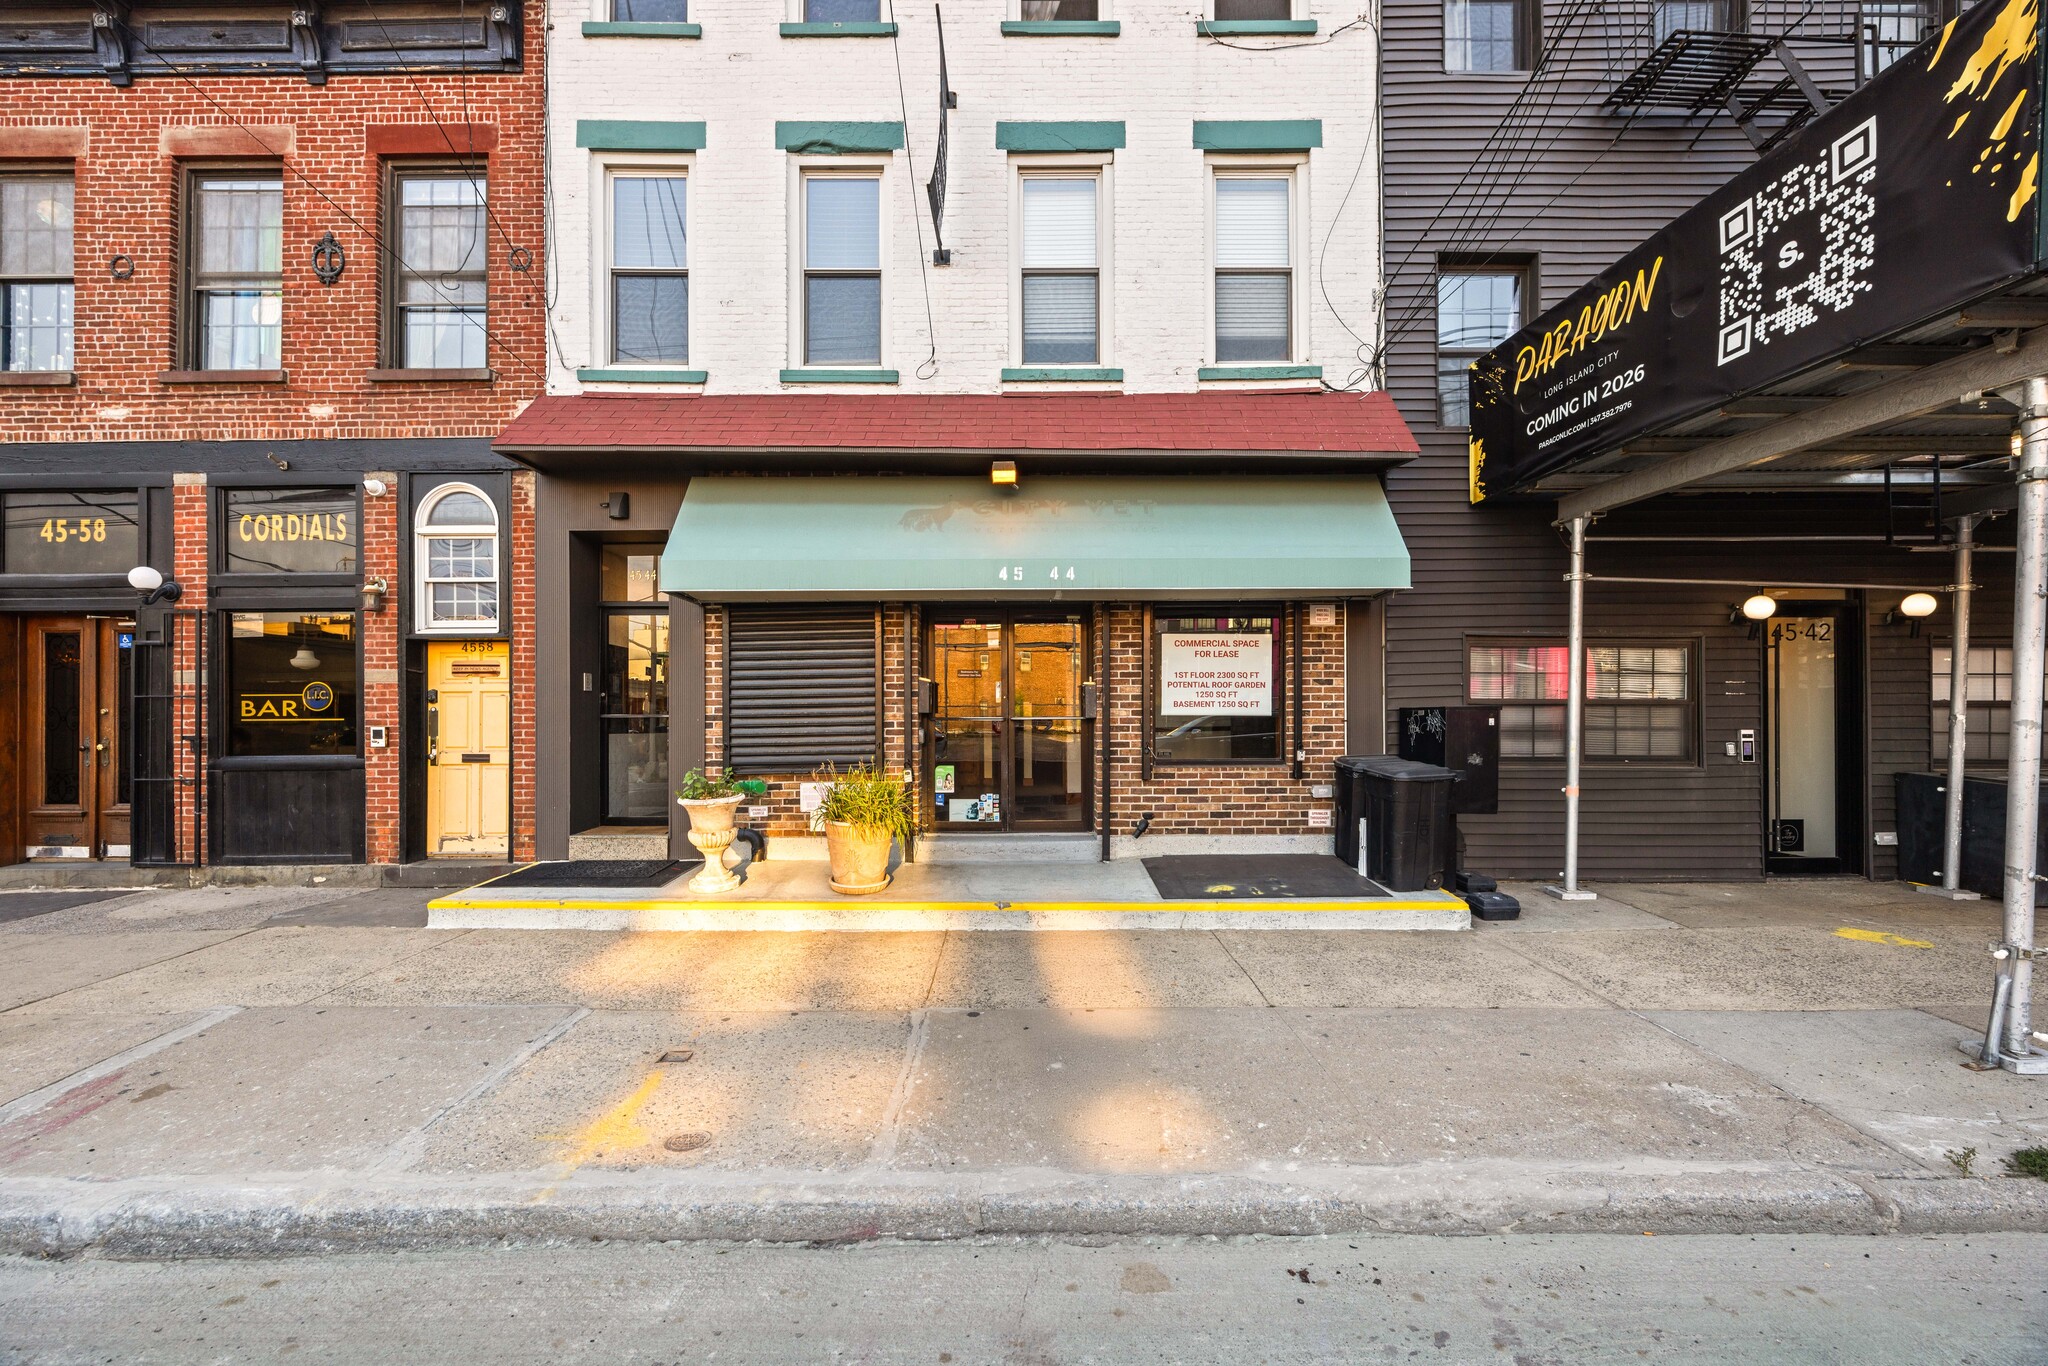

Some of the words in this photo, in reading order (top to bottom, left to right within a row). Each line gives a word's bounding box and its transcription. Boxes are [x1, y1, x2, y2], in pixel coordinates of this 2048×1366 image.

[1514, 256, 1663, 395] PARAGON
[1544, 383, 1563, 399] LONG
[1566, 364, 1595, 386] ISLAND
[1597, 350, 1620, 368] CITY
[1526, 397, 1580, 436] COMING
[1583, 386, 1598, 409] IN
[1601, 364, 1646, 399] 2026
[1539, 420, 1587, 450] PARAGONLIC.COM
[1590, 400, 1633, 425] 347.382.7976
[40, 519, 107, 543] 45-58
[239, 513, 347, 542] CORDIALS
[461, 642, 494, 652] 4558
[1174, 639, 1231, 648] COMMERCIAL
[1232, 639, 1260, 648] SPACE
[1194, 650, 1211, 658] FOR
[1213, 650, 1239, 658] LEASE
[1174, 671, 1189, 679] 1ST
[1190, 671, 1215, 679] FLOOR
[1216, 671, 1236, 679] 2300
[1237, 671, 1248, 680] SQ
[1249, 671, 1260, 679] FT
[1167, 681, 1210, 689] POTENTIAL
[1211, 681, 1233, 689] ROOF
[1234, 681, 1266, 689] GARDEN
[306, 690, 329, 700] L.I.C.
[1215, 691, 1226, 699] SQ
[241, 700, 299, 717] BAR
[1173, 700, 1215, 708] BASEMENT
[1217, 700, 1236, 708] 1250
[1237, 700, 1248, 708] SQ
[1250, 700, 1260, 708] FT
